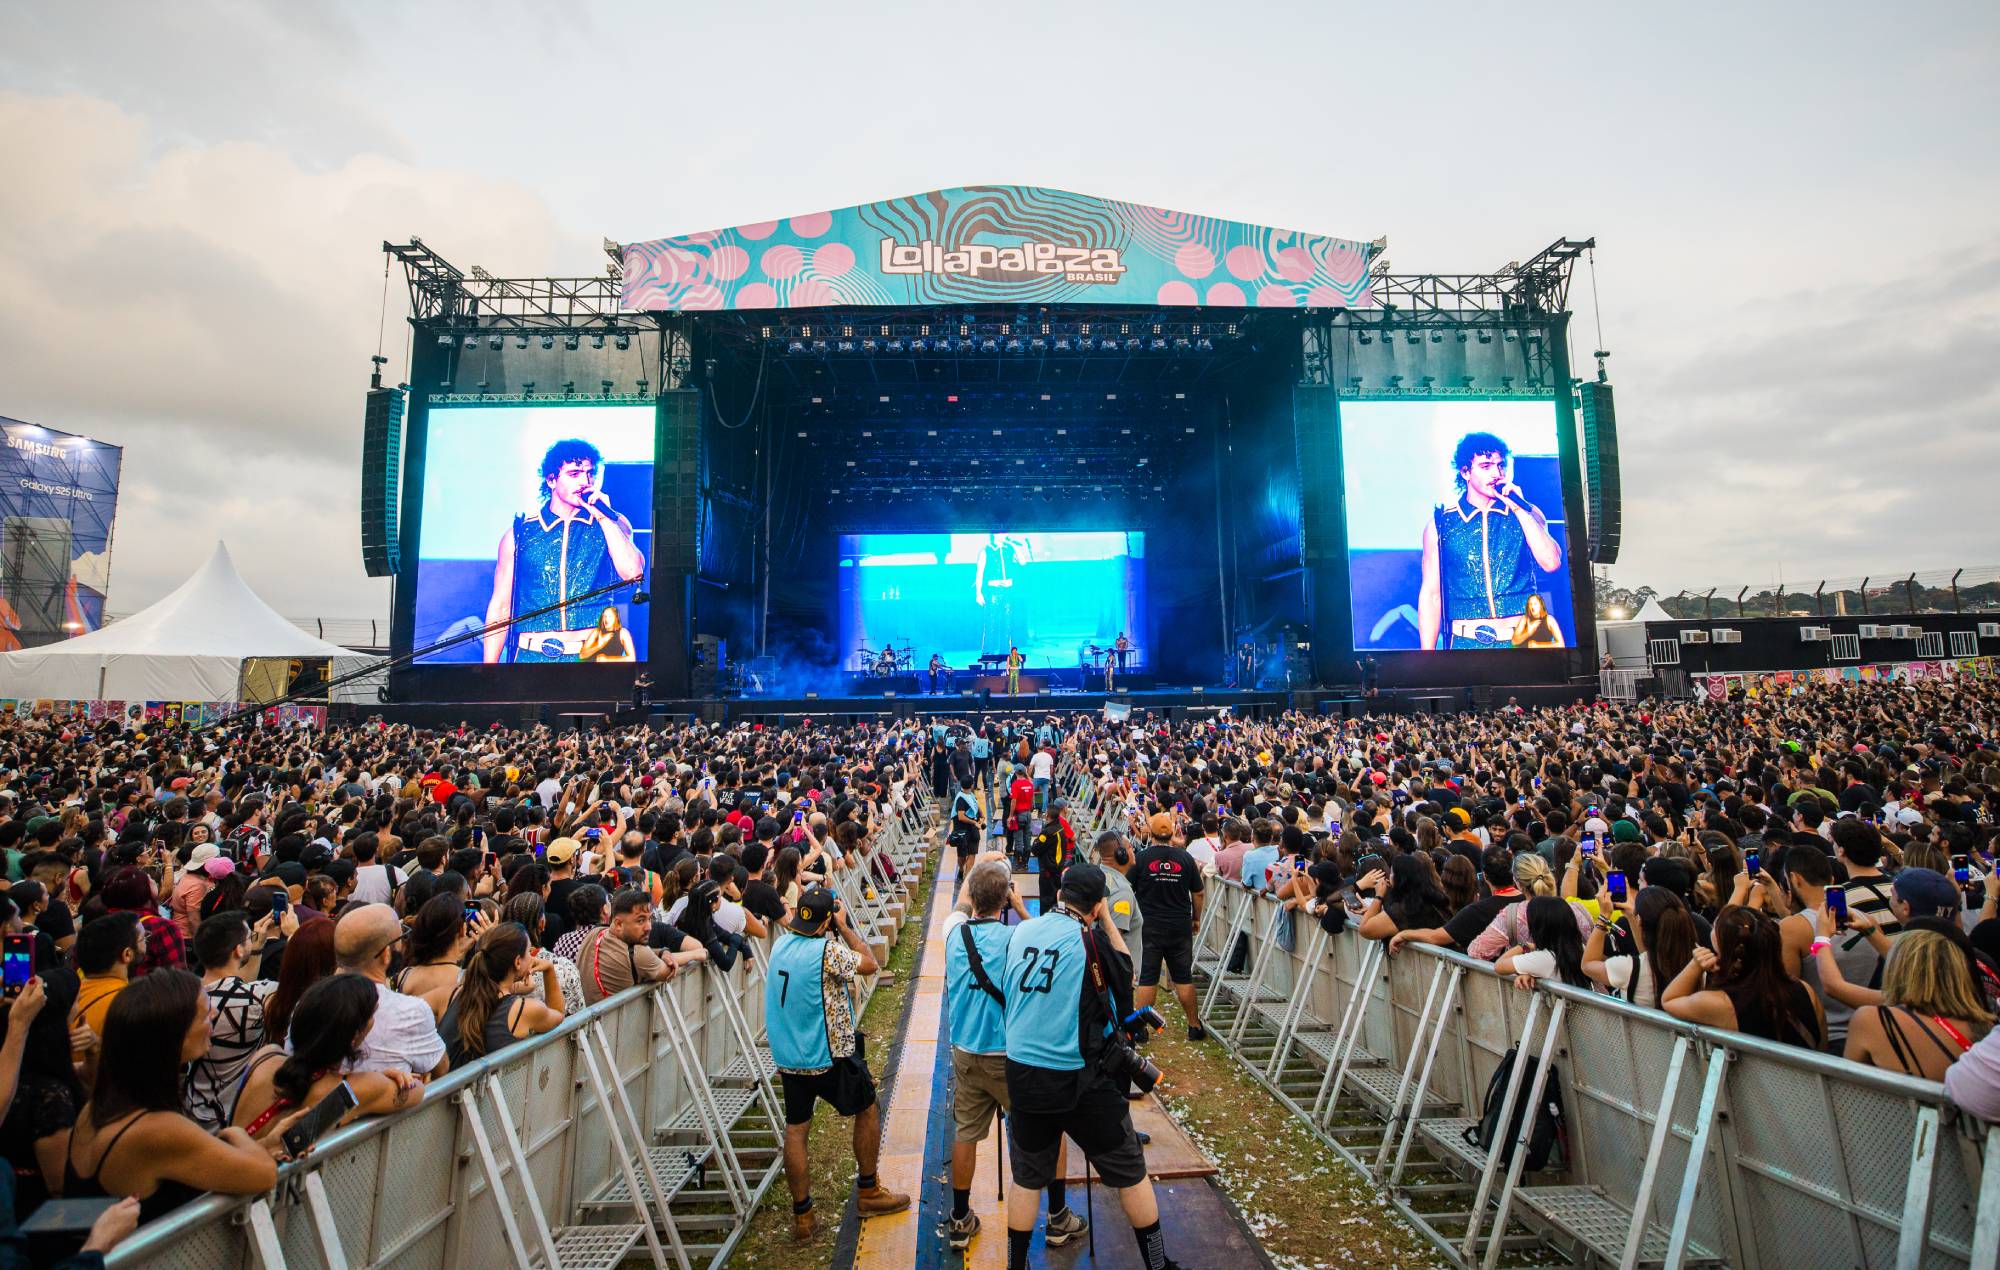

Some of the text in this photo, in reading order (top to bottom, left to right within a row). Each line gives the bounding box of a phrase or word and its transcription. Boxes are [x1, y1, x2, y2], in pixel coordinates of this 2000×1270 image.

[881, 237, 1126, 276] Lollapalooza
[1066, 273, 1117, 282] BRASIL
[7, 436, 67, 460] SAMSUNG
[20, 479, 93, 500] Galaxy S25 Ultra
[1935, 905, 1954, 918] NY
[1019, 946, 1060, 994] 23
[778, 969, 790, 1009] 7
